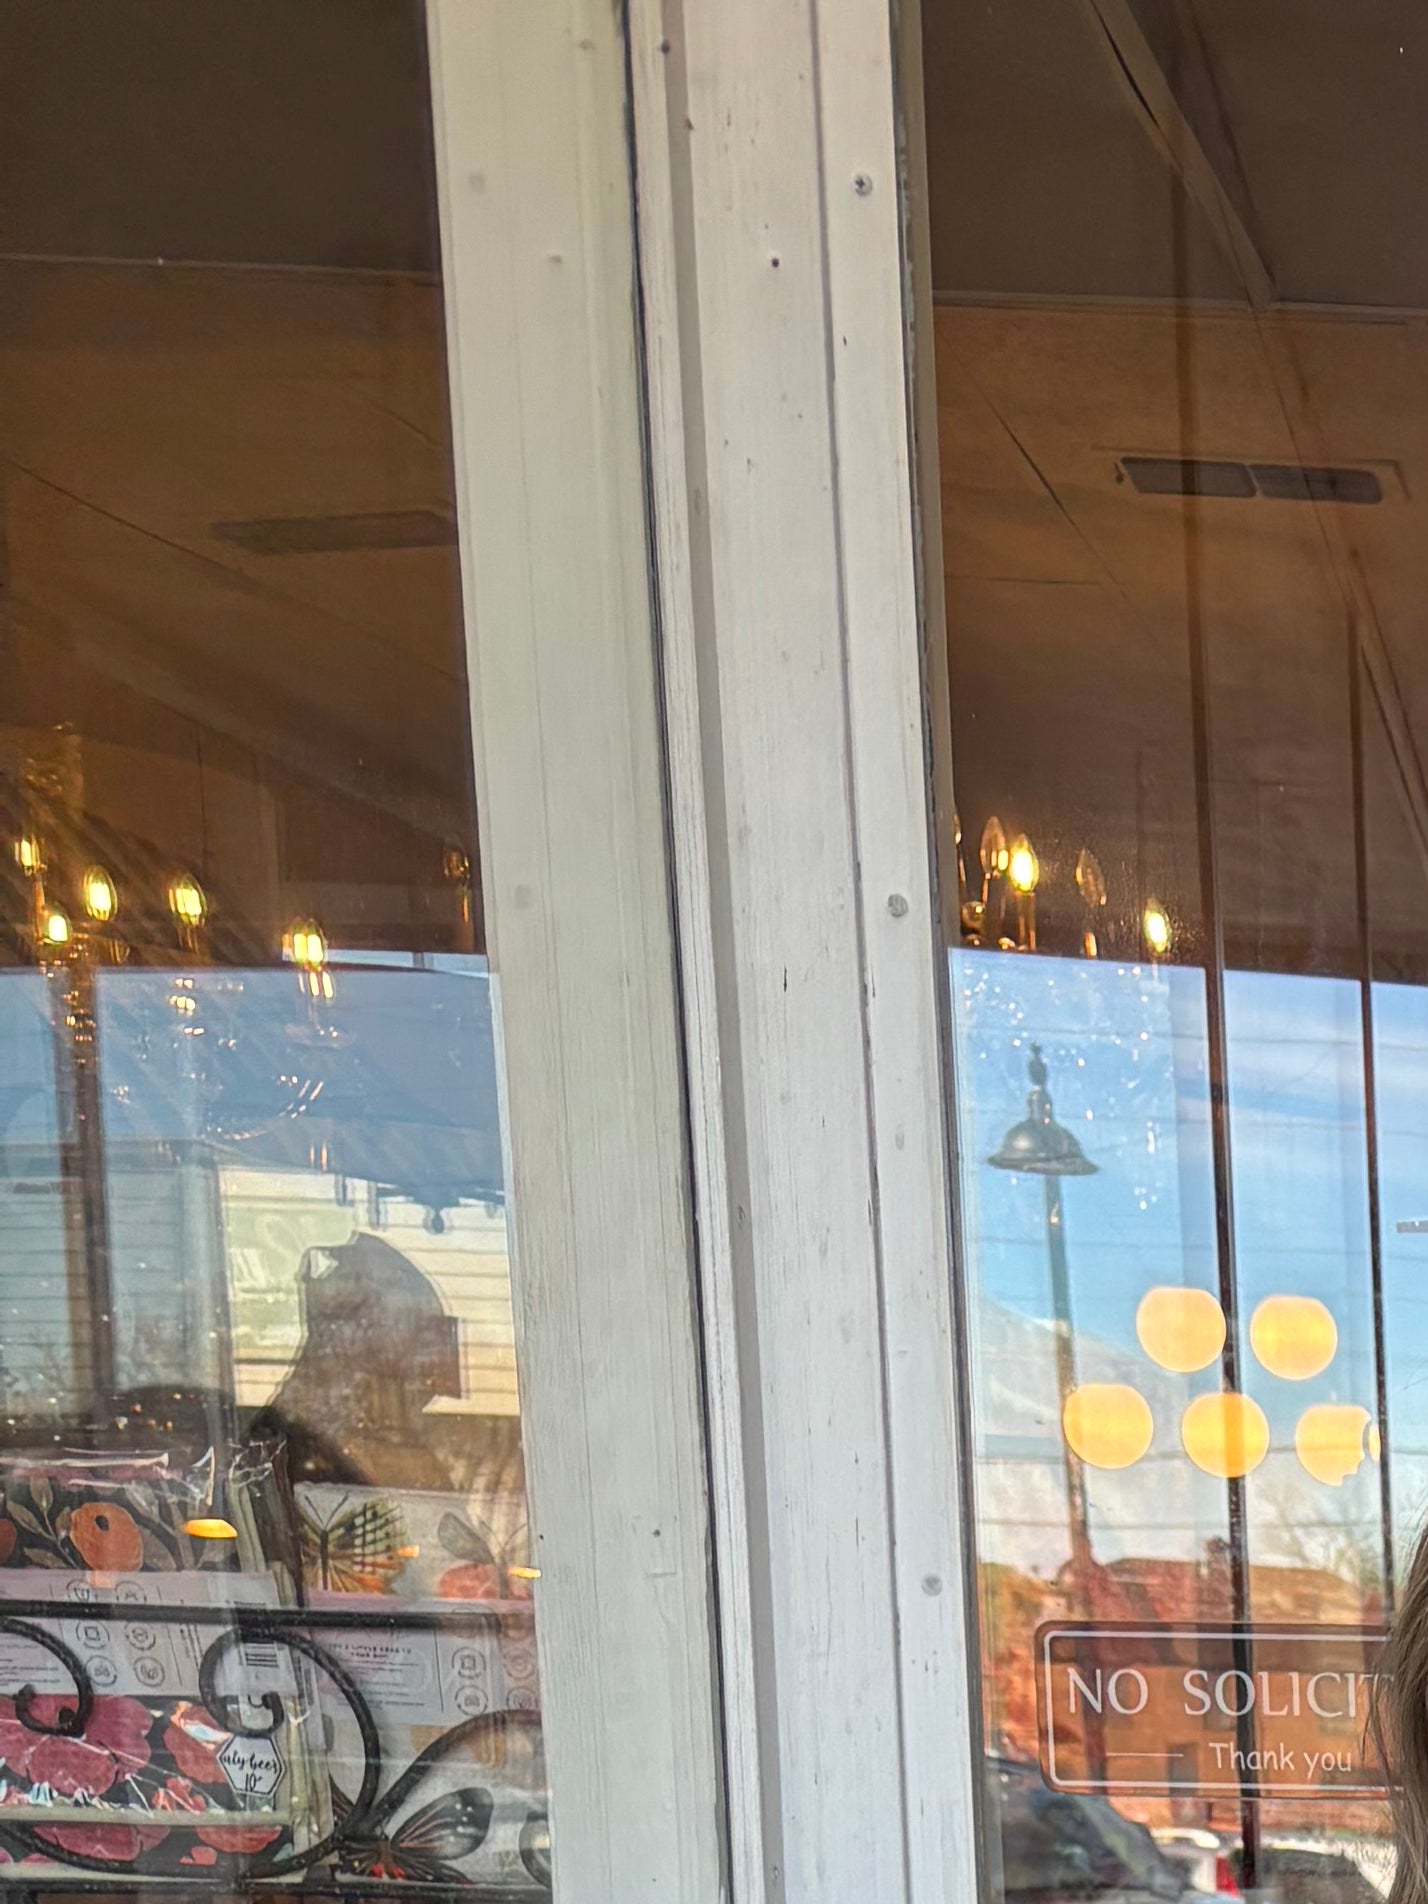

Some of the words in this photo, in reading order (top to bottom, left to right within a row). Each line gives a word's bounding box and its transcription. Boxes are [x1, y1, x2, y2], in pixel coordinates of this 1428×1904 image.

[1066, 1667, 1149, 1715] NO
[1208, 1741, 1296, 1772] Thank
[1304, 1750, 1353, 1779] you
